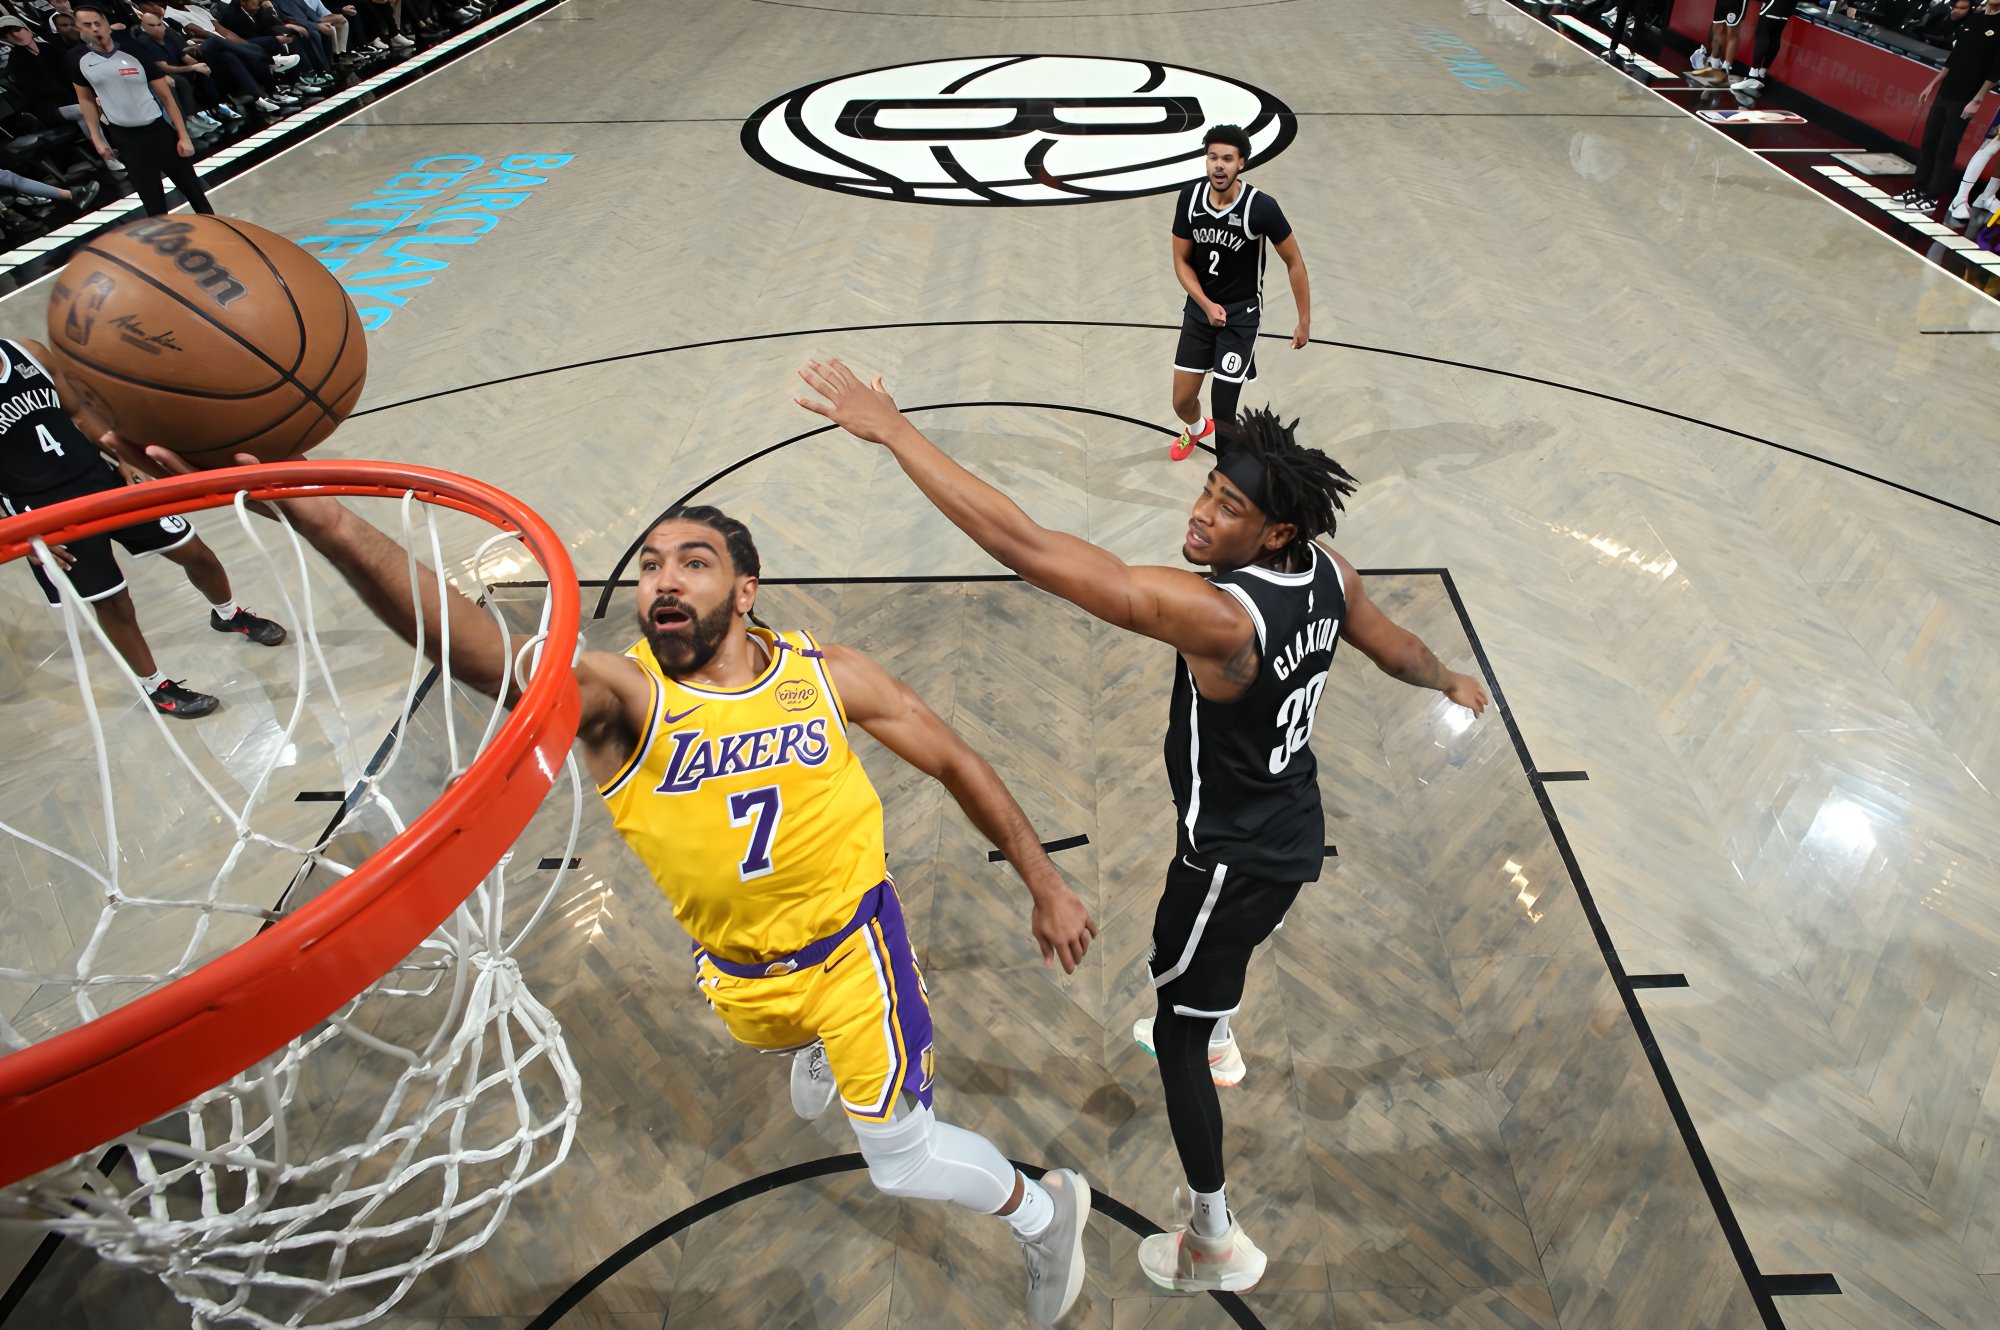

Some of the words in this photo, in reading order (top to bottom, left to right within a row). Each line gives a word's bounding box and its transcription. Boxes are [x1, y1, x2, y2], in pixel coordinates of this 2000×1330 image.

[1192, 227, 1246, 252] ROOKLYN
[1208, 250, 1220, 276] 2
[35, 423, 65, 457] 4
[1268, 670, 1329, 775] 33
[653, 716, 831, 795] LAKERS
[725, 783, 784, 883] 7
